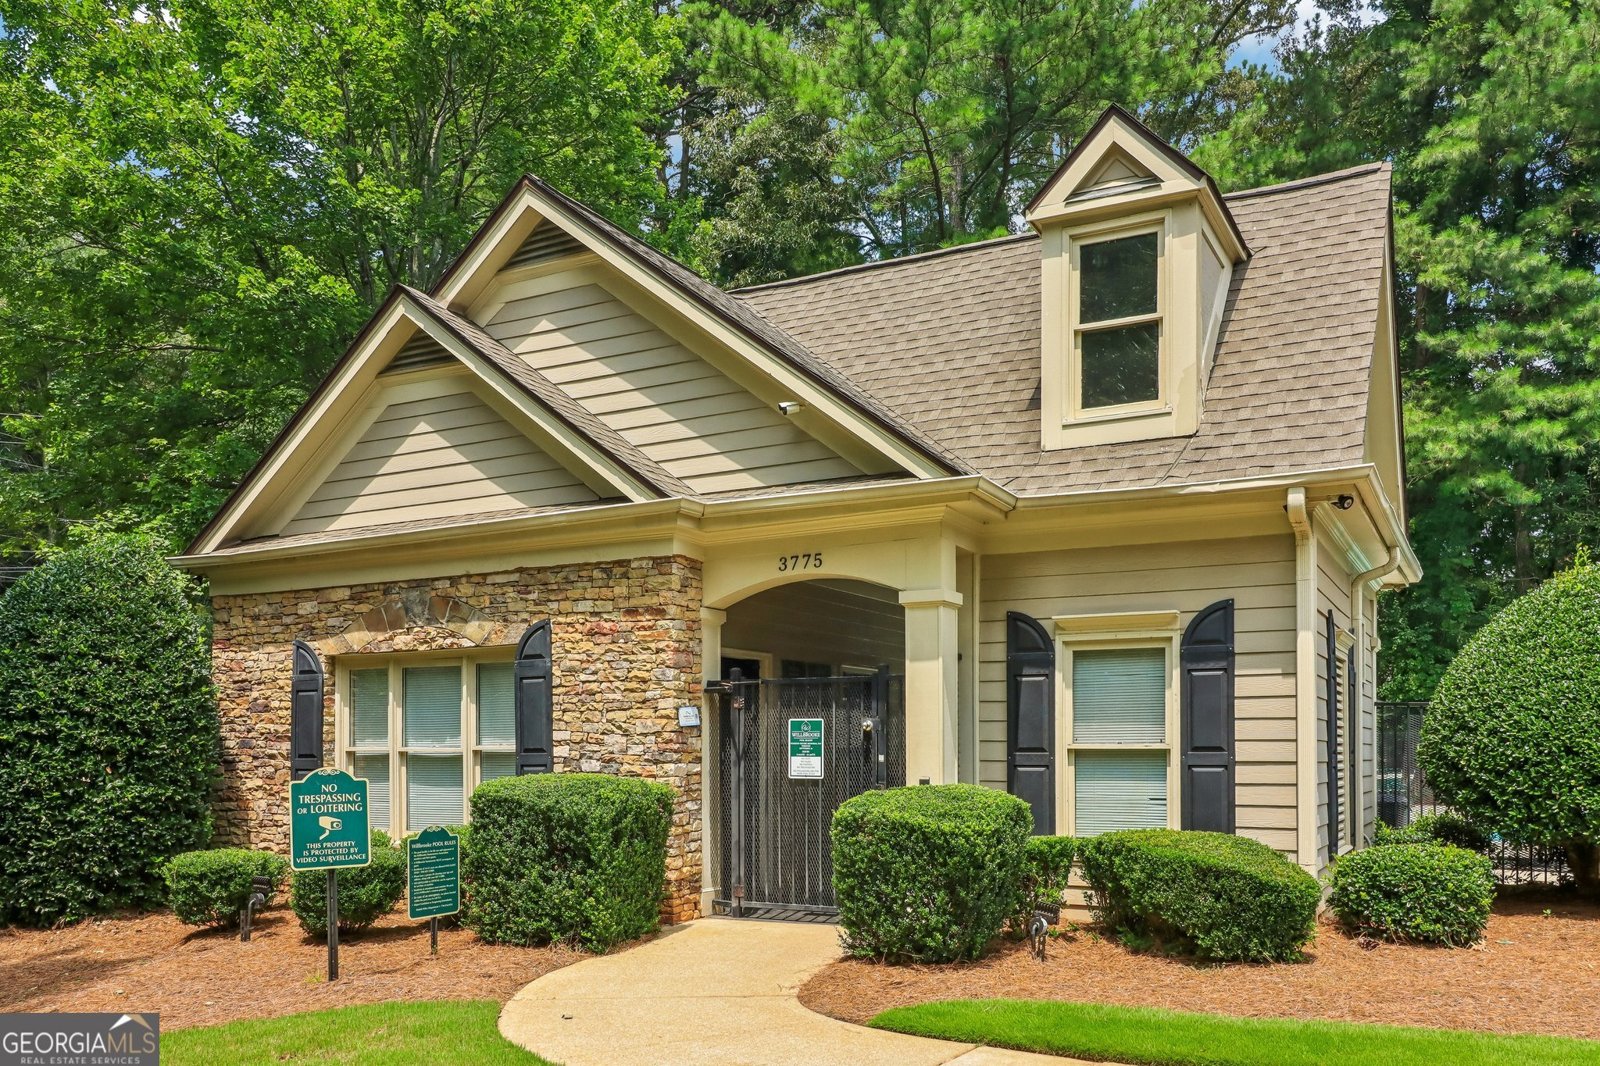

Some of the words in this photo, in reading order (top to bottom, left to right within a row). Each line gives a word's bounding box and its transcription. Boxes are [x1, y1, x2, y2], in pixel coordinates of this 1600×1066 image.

[778, 552, 823, 572] 3775
[321, 784, 338, 793] NO
[298, 792, 361, 804] TRESPASSING
[310, 802, 363, 814] LOITERING
[319, 854, 366, 862] SURVEILLANCE
